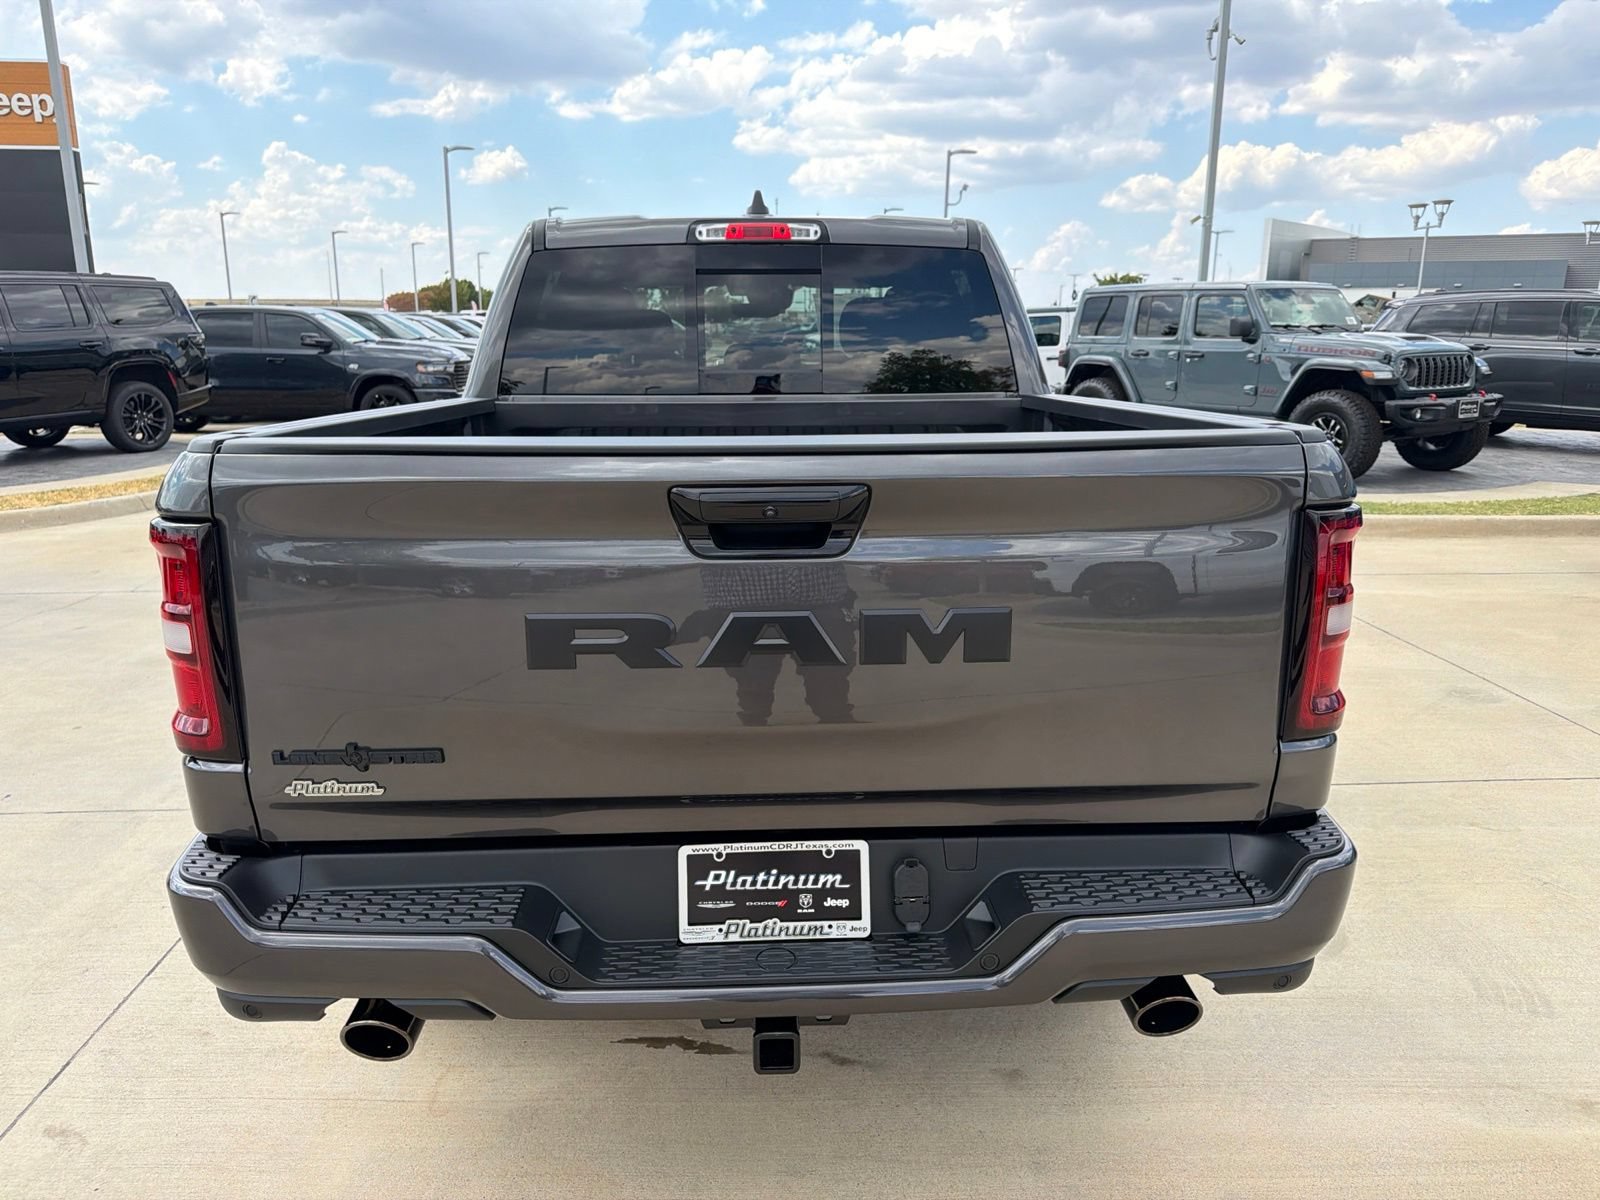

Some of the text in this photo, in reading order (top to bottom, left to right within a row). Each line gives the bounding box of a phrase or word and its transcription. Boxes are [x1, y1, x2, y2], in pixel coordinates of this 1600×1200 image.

[526, 607, 1013, 669] RAM
[285, 779, 386, 797] Platinum
[691, 842, 855, 853] www.PlatinumCDRJTexas.com
[694, 868, 851, 891] Platinum
[823, 897, 850, 908] Jeep
[722, 919, 833, 940] Platinum
[849, 925, 868, 933] Jeep
